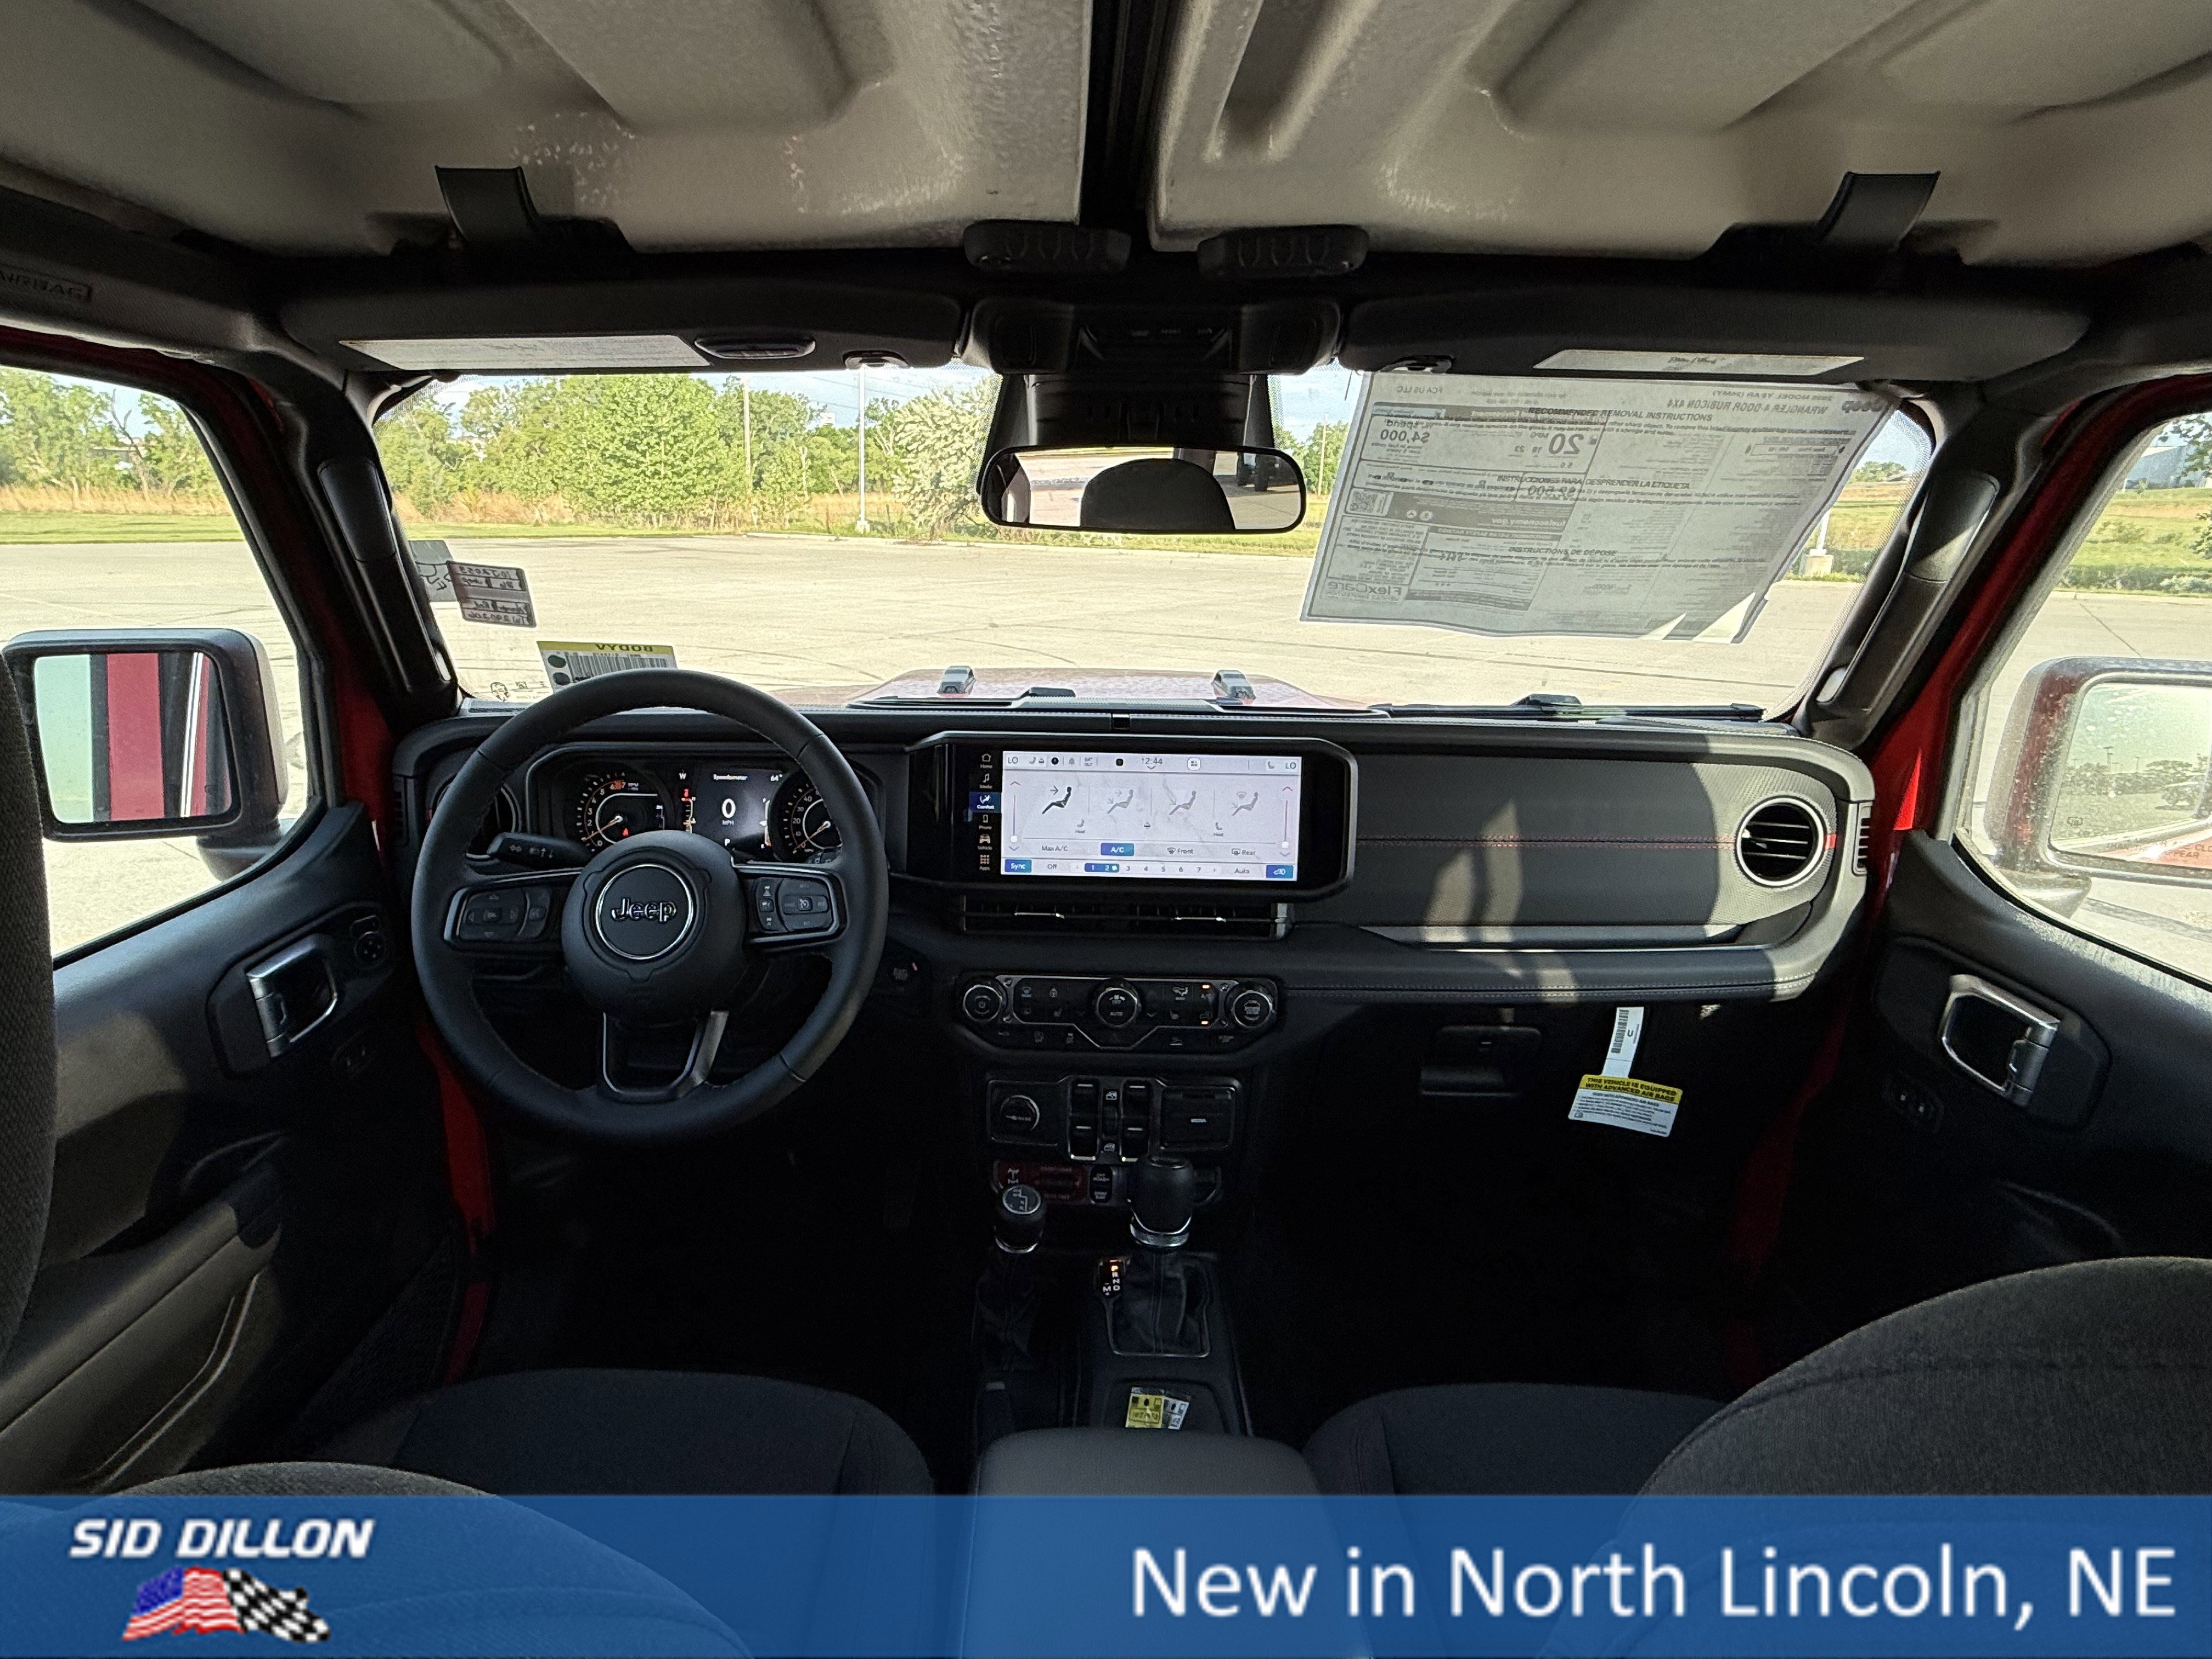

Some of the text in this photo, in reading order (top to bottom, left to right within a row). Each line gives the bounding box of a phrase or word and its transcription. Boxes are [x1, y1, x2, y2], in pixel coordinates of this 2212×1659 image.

[1528, 408, 1713, 421] RECOMMENDED REMOVAL INSTRUCTIONS
[1585, 478, 1639, 487] DESPRENDER
[1651, 481, 1690, 489] ETIQUETA
[1508, 546, 1569, 555] INSTRUCTIONS
[721, 798, 736, 819] 0
[1011, 862, 1026, 871] Sync
[611, 898, 678, 924] Jeep
[1604, 1085, 1640, 1094] ADVANCED
[1655, 1093, 1675, 1102] BAGS
[1640, 1084, 1677, 1096] EQUIPPED
